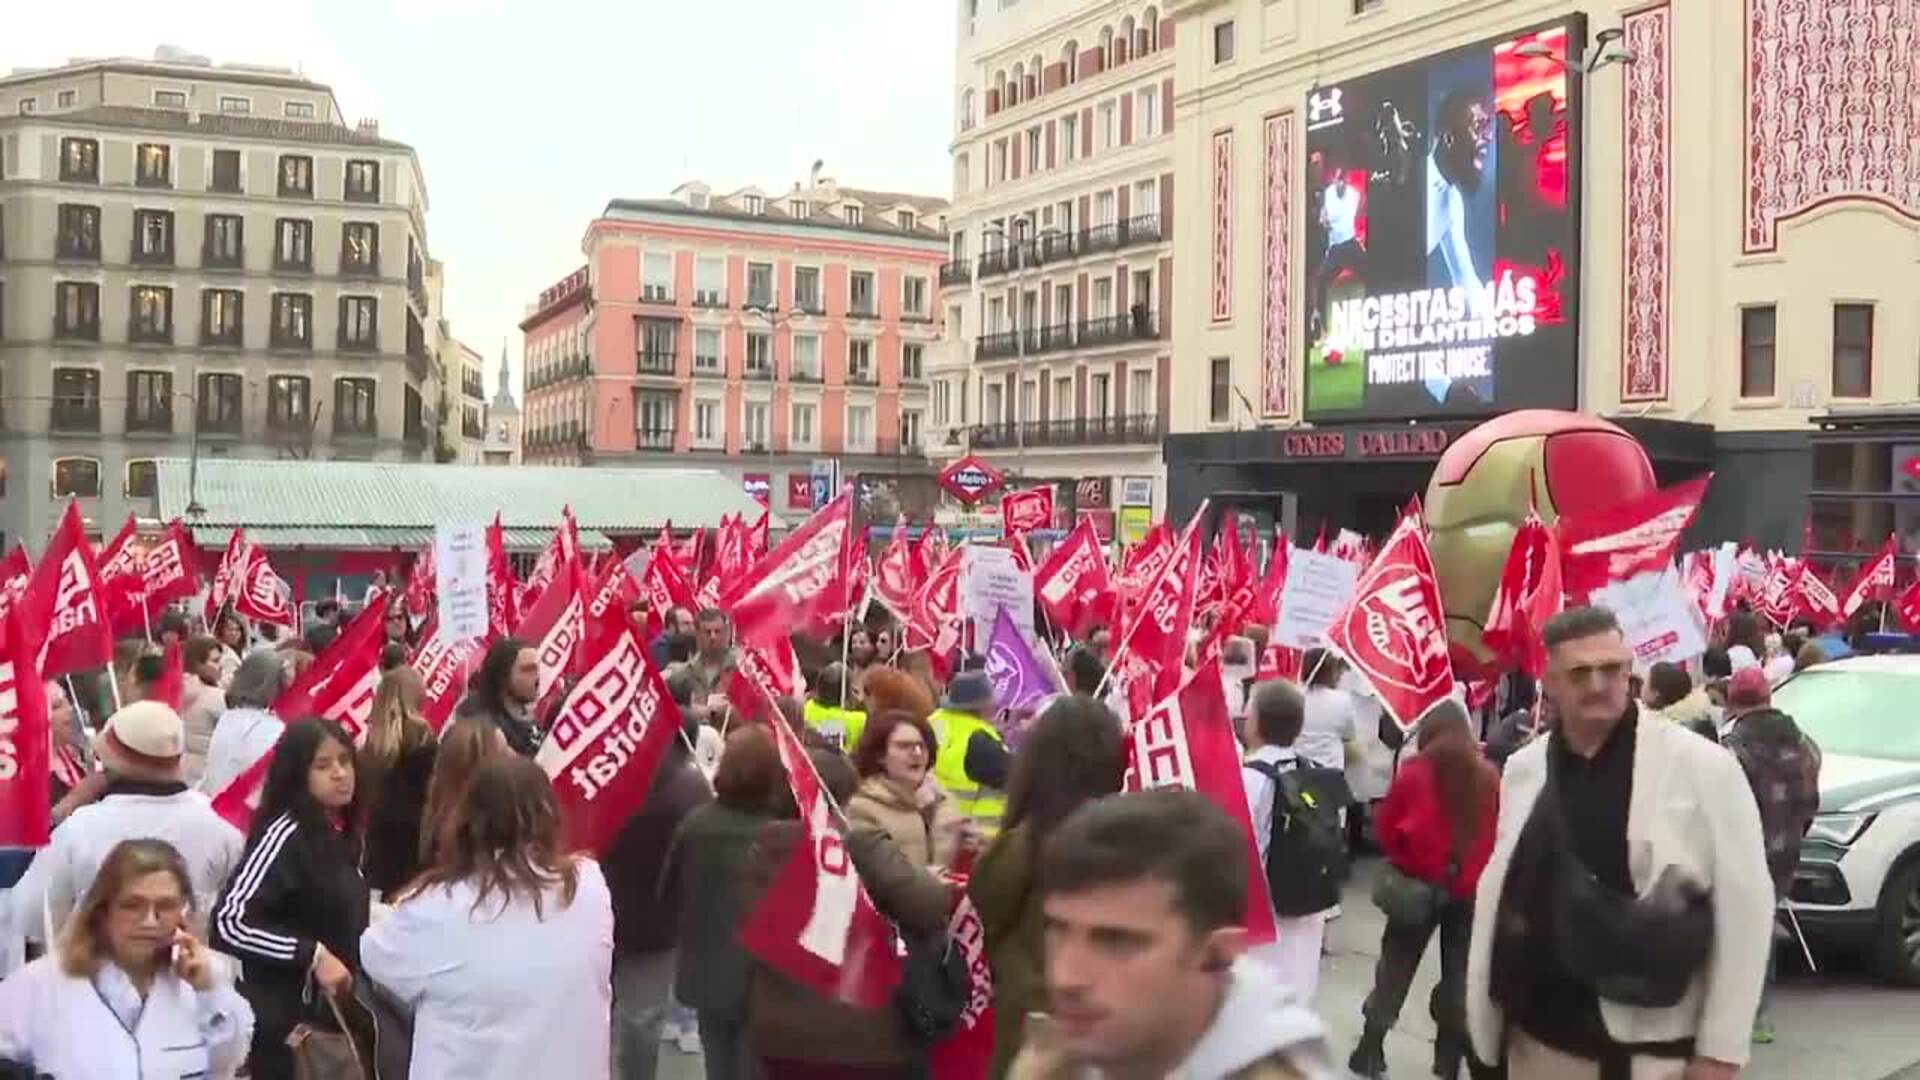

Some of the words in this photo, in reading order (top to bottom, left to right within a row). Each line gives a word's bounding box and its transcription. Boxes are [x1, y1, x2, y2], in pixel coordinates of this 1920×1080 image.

[1331, 287, 1466, 337] NECESITAS
[1469, 269, 1537, 321] MÁS
[1379, 314, 1537, 349] DELANTEROS
[1368, 352, 1416, 385] PROTECT
[1418, 348, 1445, 381] THIS
[1284, 432, 1345, 457] CINES
[956, 472, 988, 487] Metro
